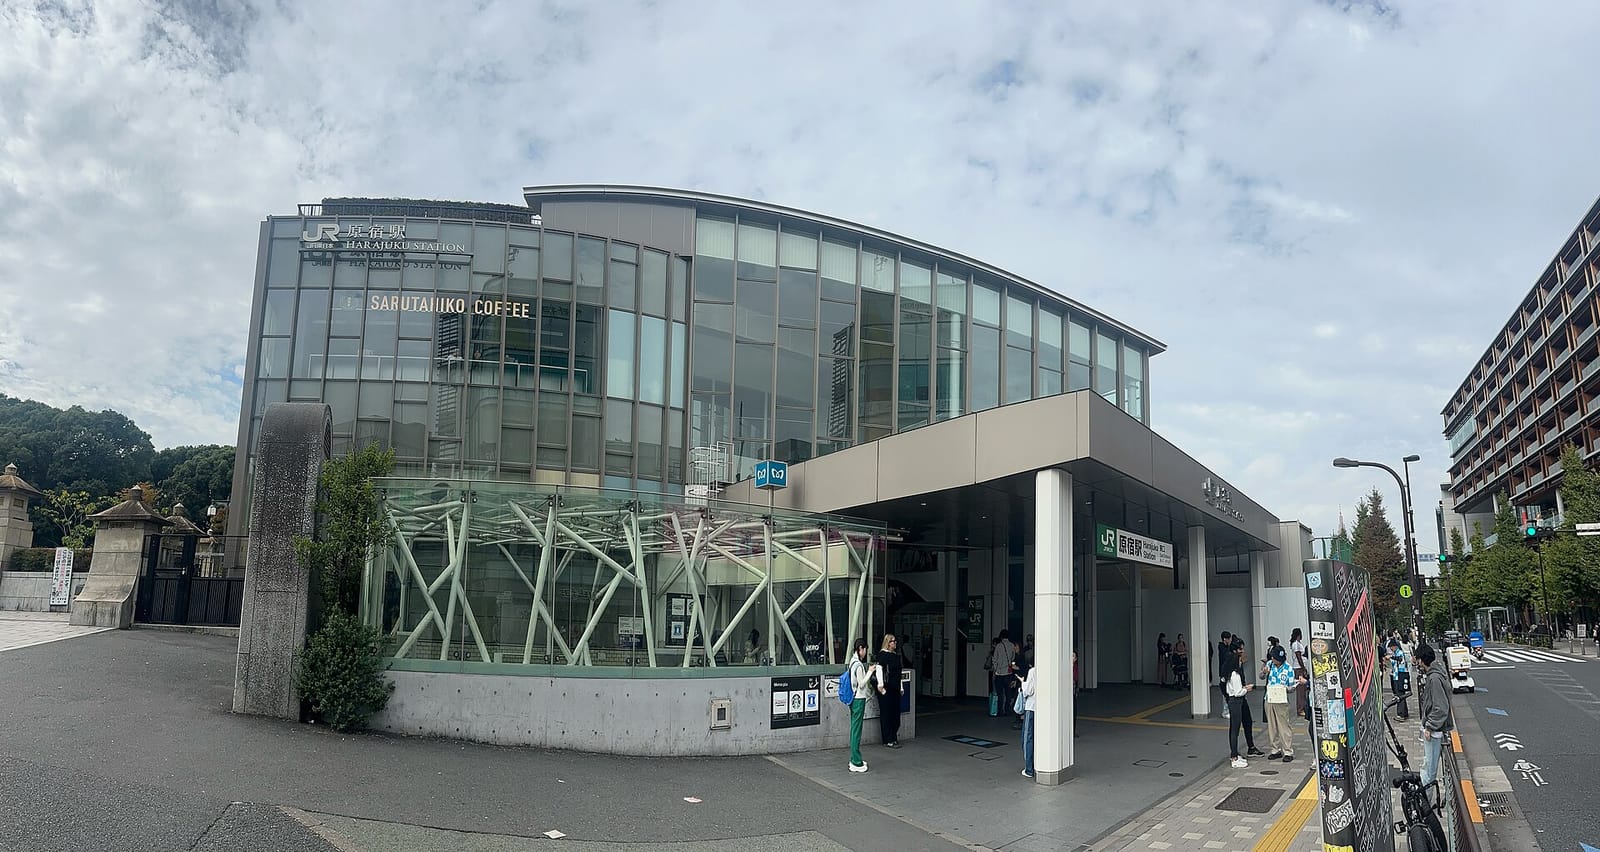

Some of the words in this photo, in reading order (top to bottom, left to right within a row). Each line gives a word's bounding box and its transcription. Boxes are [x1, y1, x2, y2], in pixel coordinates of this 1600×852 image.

[302, 223, 340, 242] JR
[346, 224, 406, 239] 原宿駅
[346, 241, 410, 250] HARAJUKU
[414, 242, 465, 252] STATION
[370, 295, 465, 313] SARUTAHIKO
[474, 299, 530, 318] COFFEE
[1101, 529, 1115, 547] JR
[1119, 535, 1142, 557] 原宿駅
[969, 613, 981, 623] JR
